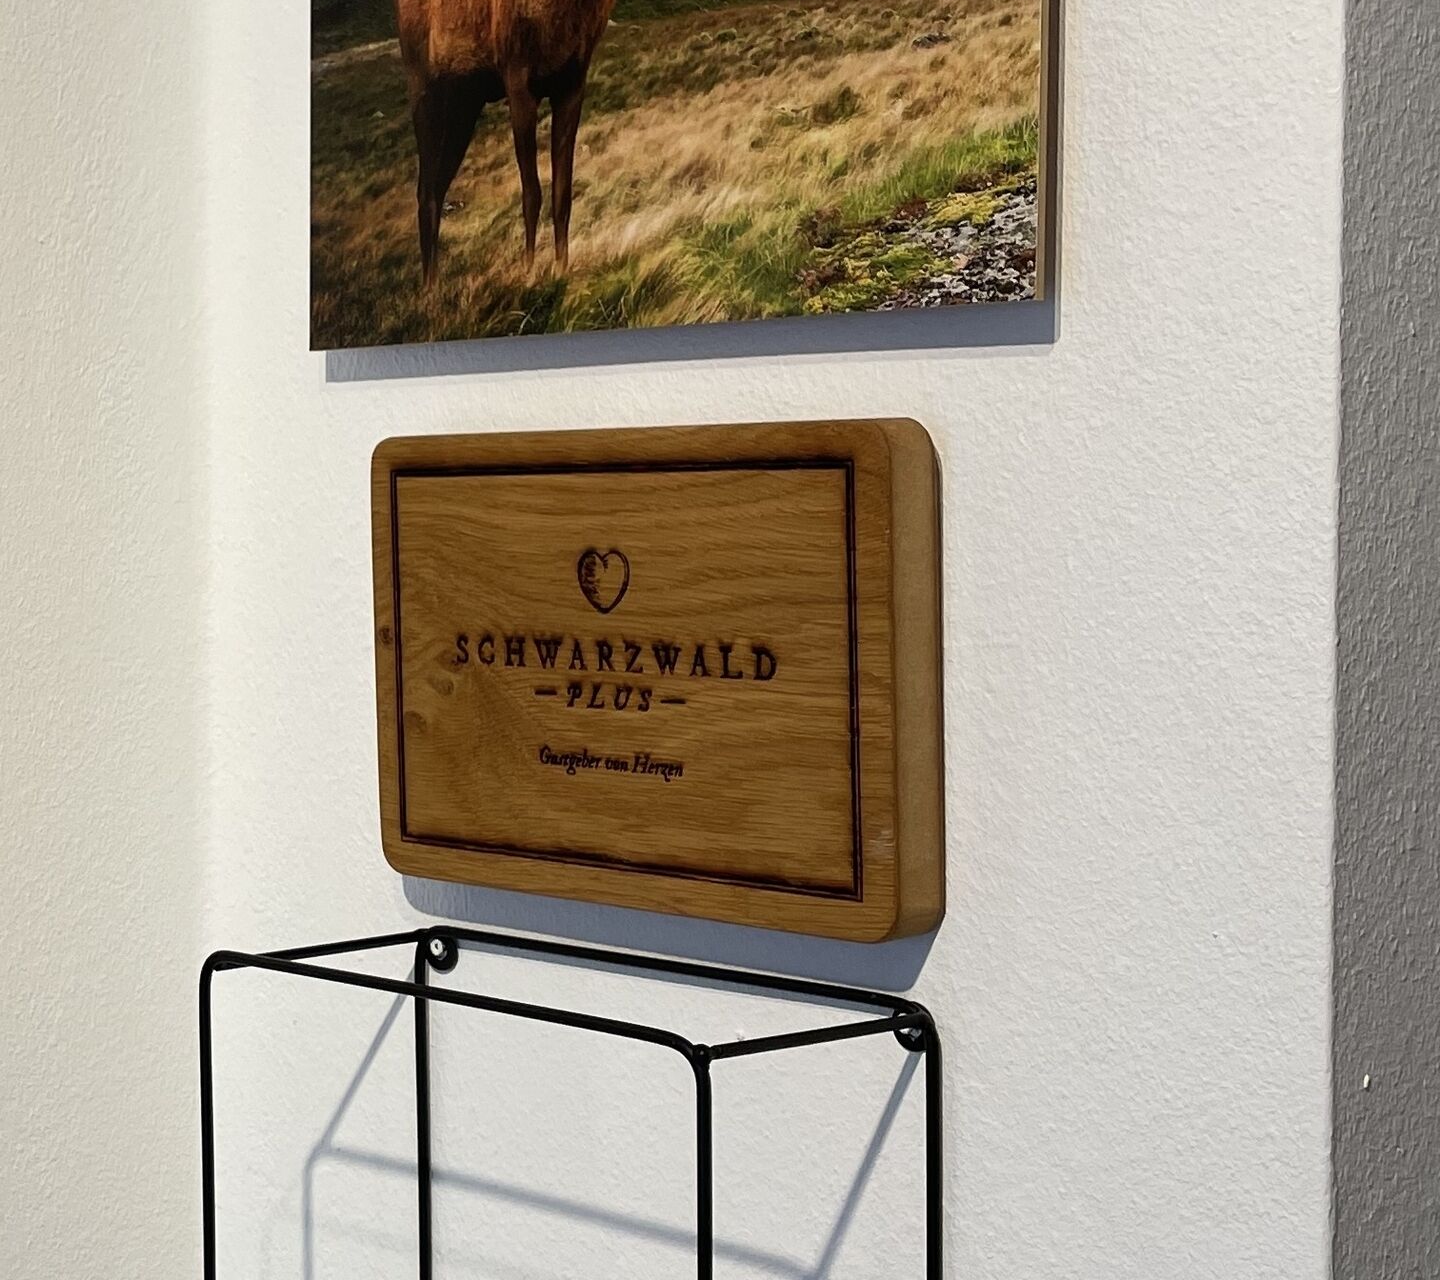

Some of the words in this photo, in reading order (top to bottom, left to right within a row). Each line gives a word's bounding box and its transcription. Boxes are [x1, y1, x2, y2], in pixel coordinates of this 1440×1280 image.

[454, 634, 777, 681] SCHWARZWALD
[539, 745, 601, 774] Gastgeber
[606, 755, 630, 773] von
[633, 753, 684, 782] Herzen
